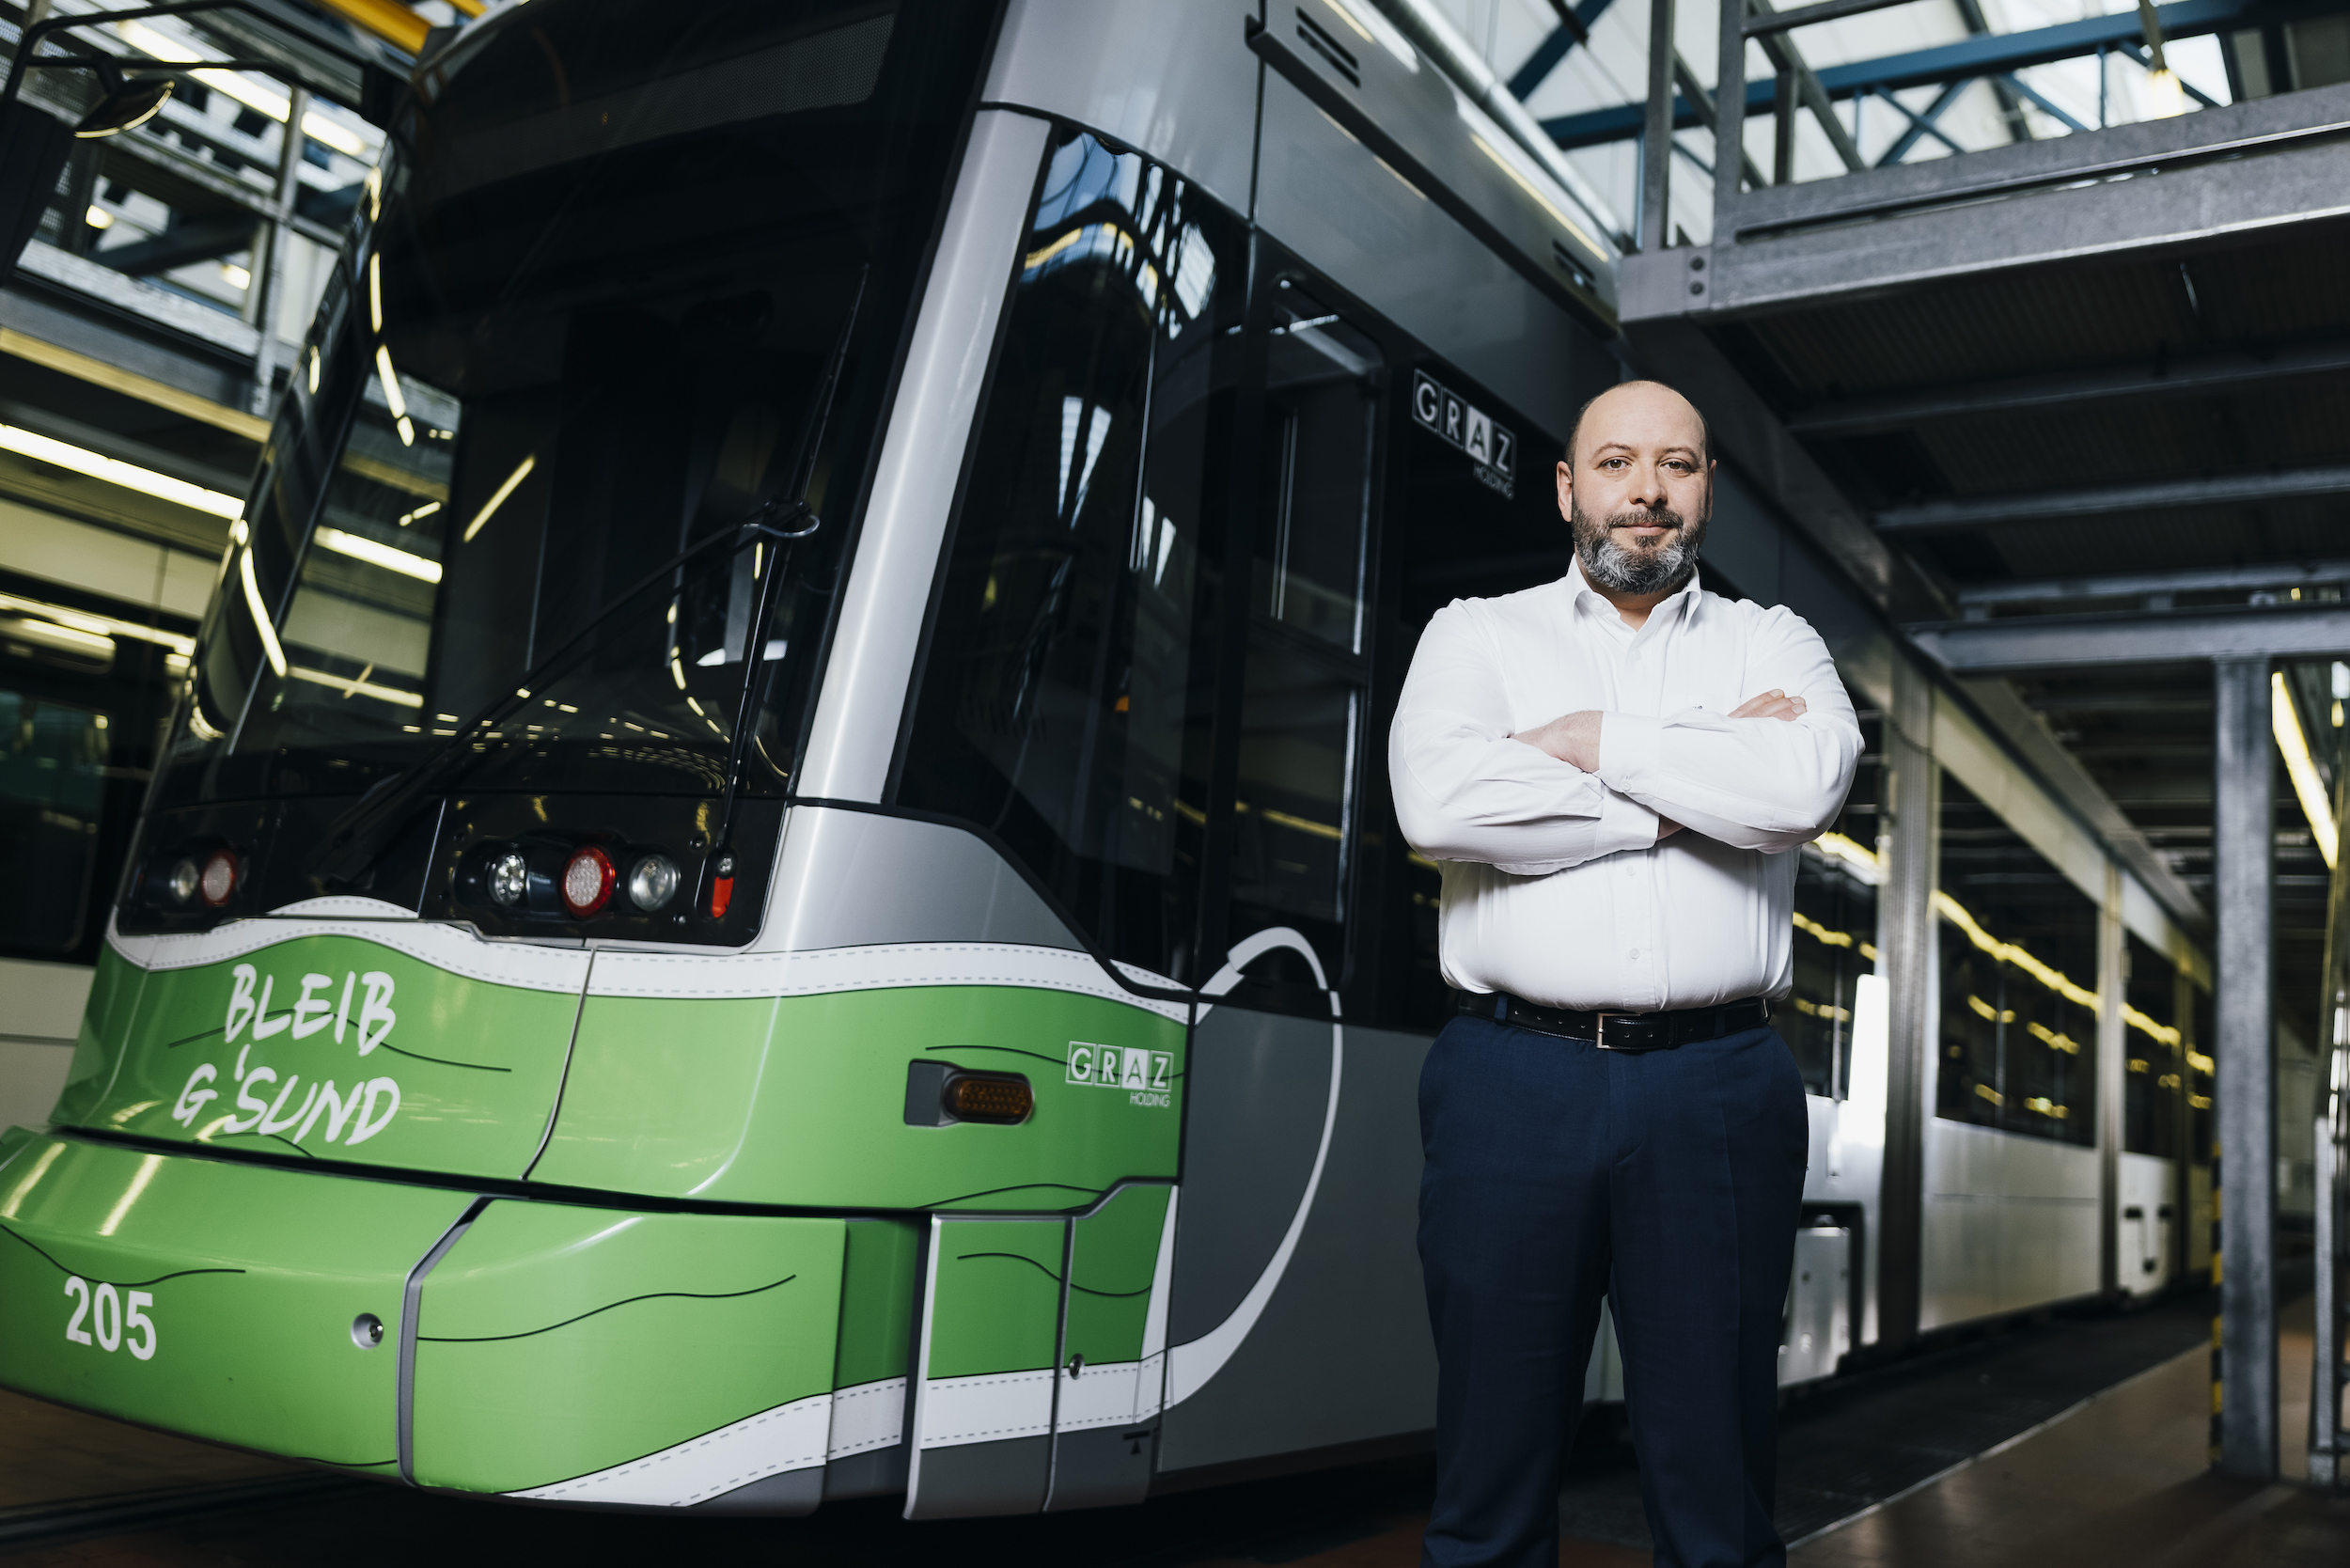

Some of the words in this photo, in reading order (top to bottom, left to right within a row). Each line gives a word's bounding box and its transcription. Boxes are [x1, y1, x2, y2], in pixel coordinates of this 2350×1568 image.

[1416, 380, 1511, 472] GRAZ
[225, 963, 397, 1057] BLEIB
[1070, 1046, 1168, 1088] GRAZ
[1129, 1091, 1171, 1107] HOLDING
[64, 1275, 157, 1360] 205
